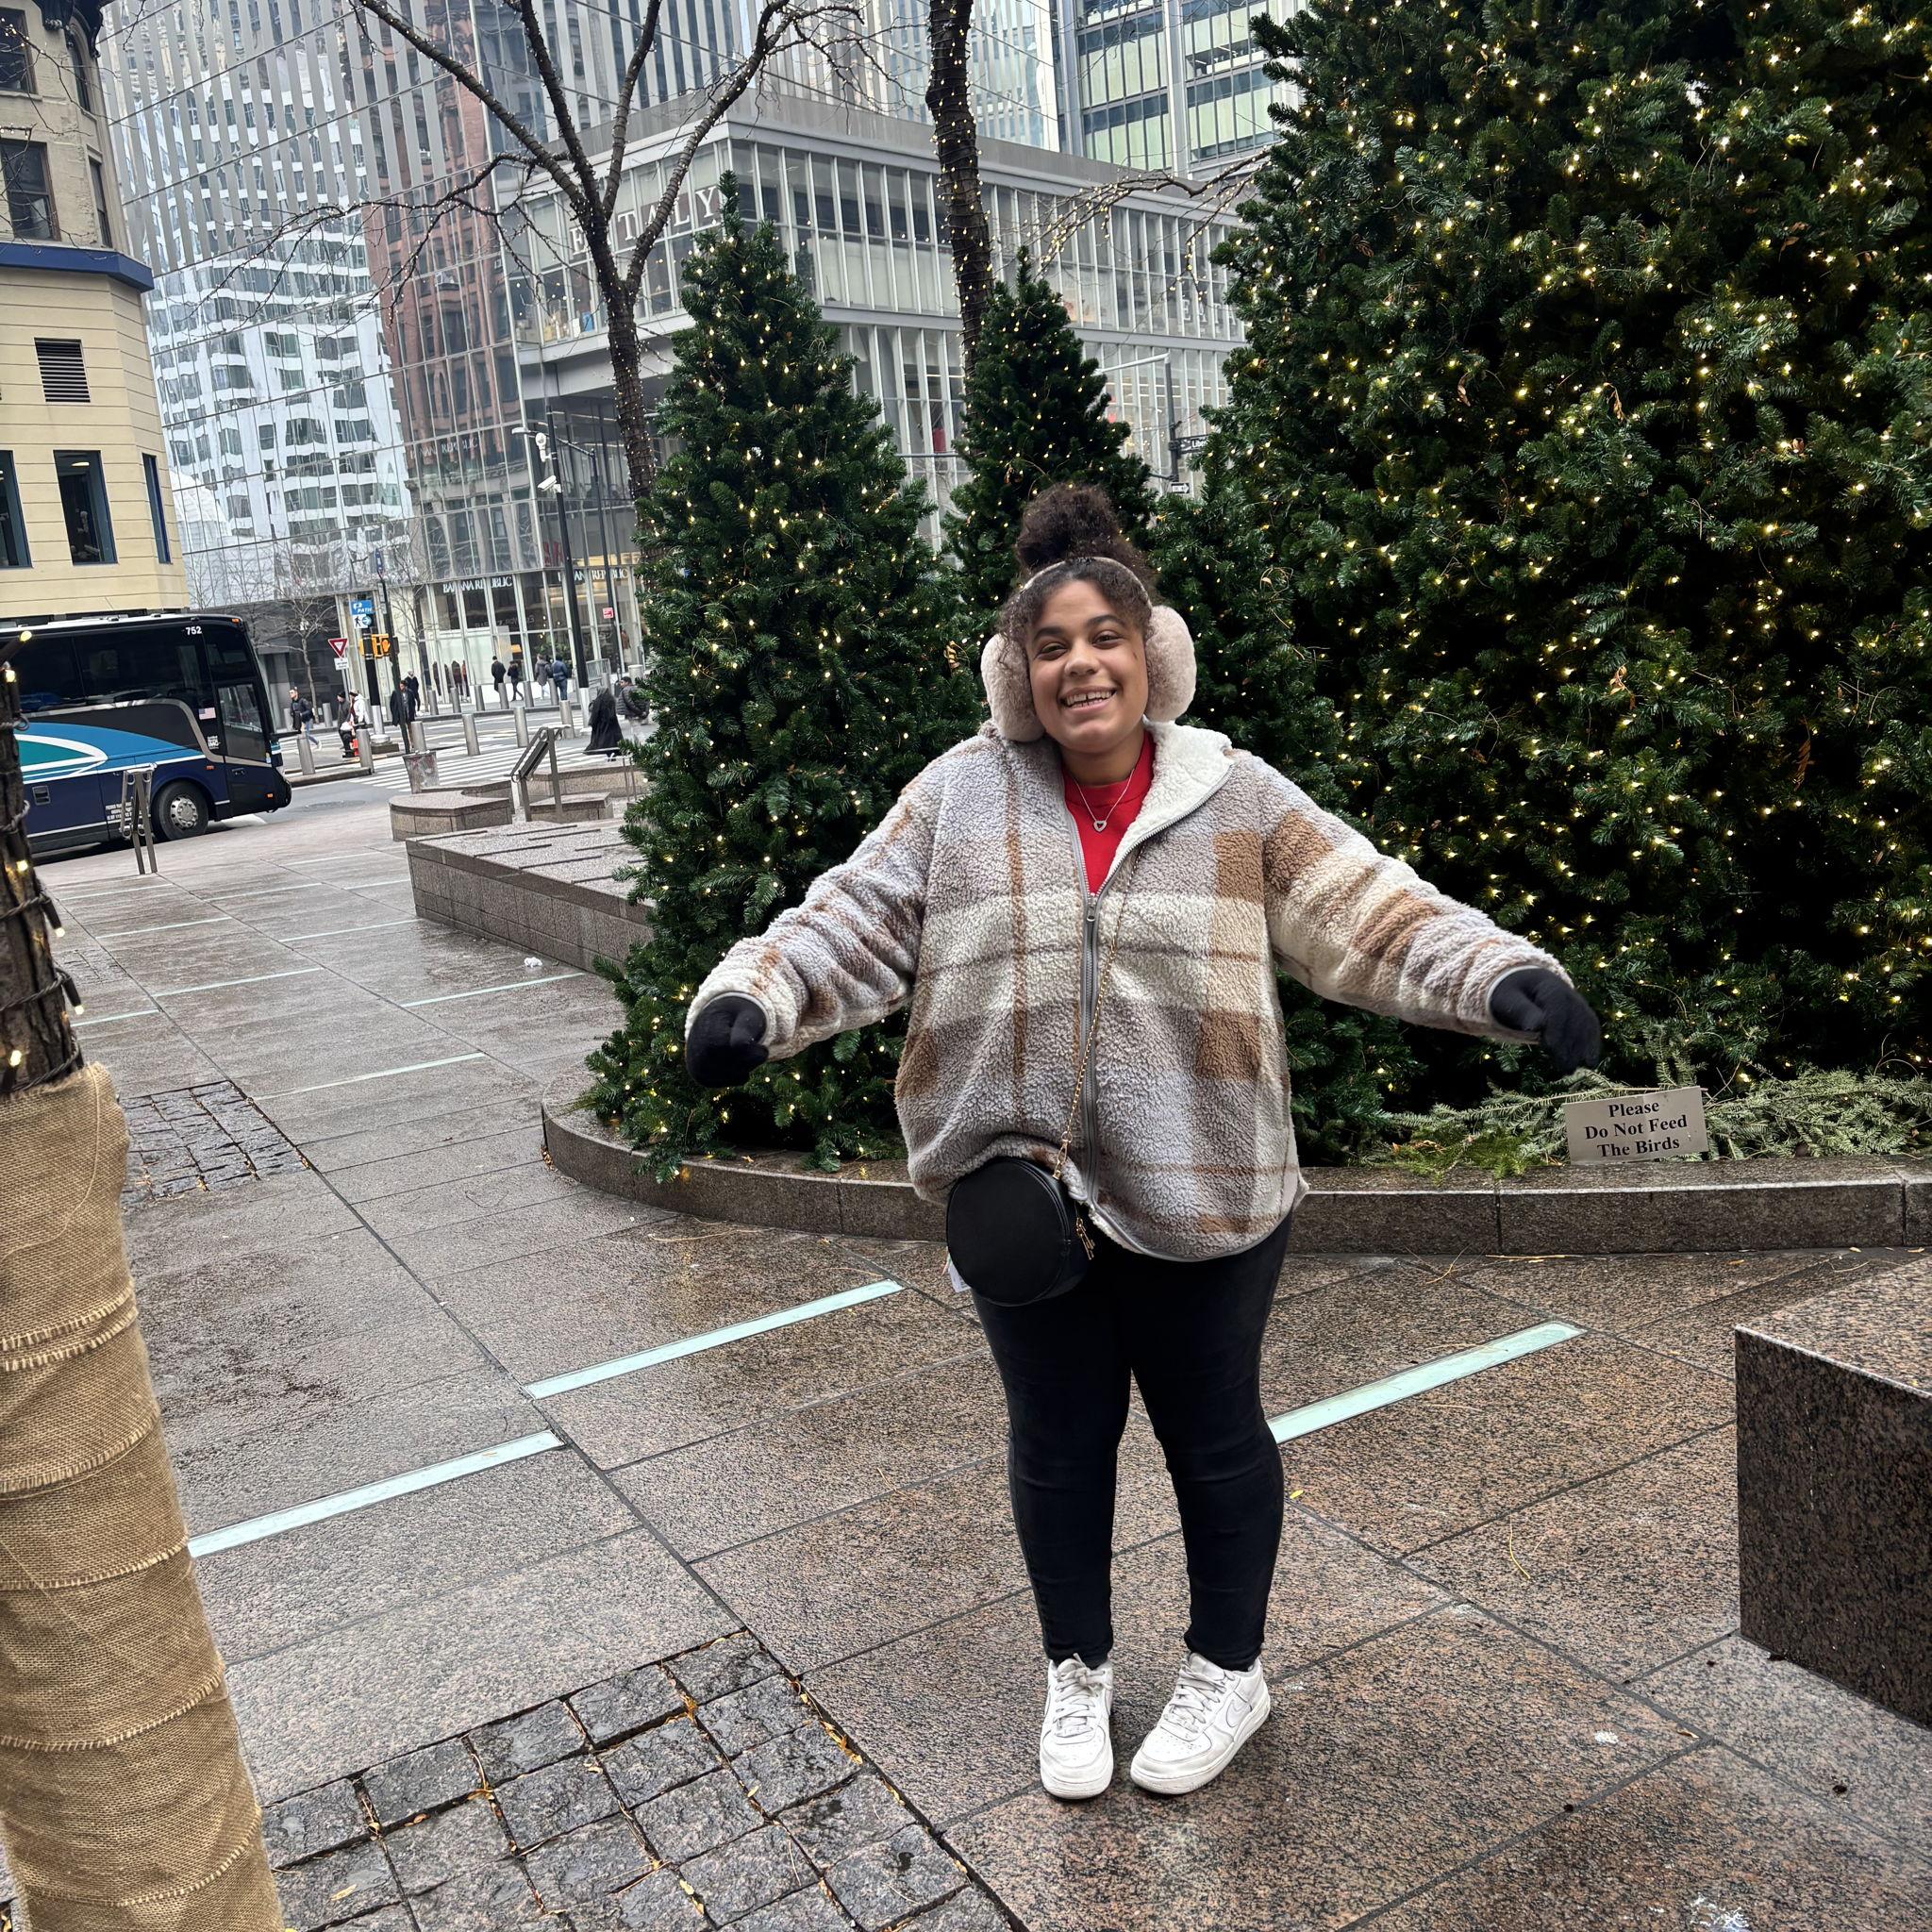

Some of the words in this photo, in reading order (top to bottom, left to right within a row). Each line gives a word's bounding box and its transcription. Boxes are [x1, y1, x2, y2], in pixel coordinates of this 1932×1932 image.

[185, 625, 202, 636] 752
[1607, 1102, 1660, 1118] Please
[1585, 1125, 1608, 1140] Do
[1613, 1122, 1643, 1137] Not
[1649, 1114, 1688, 1133] Feed
[1596, 1143, 1630, 1158] The
[1635, 1137, 1680, 1155] Birds
